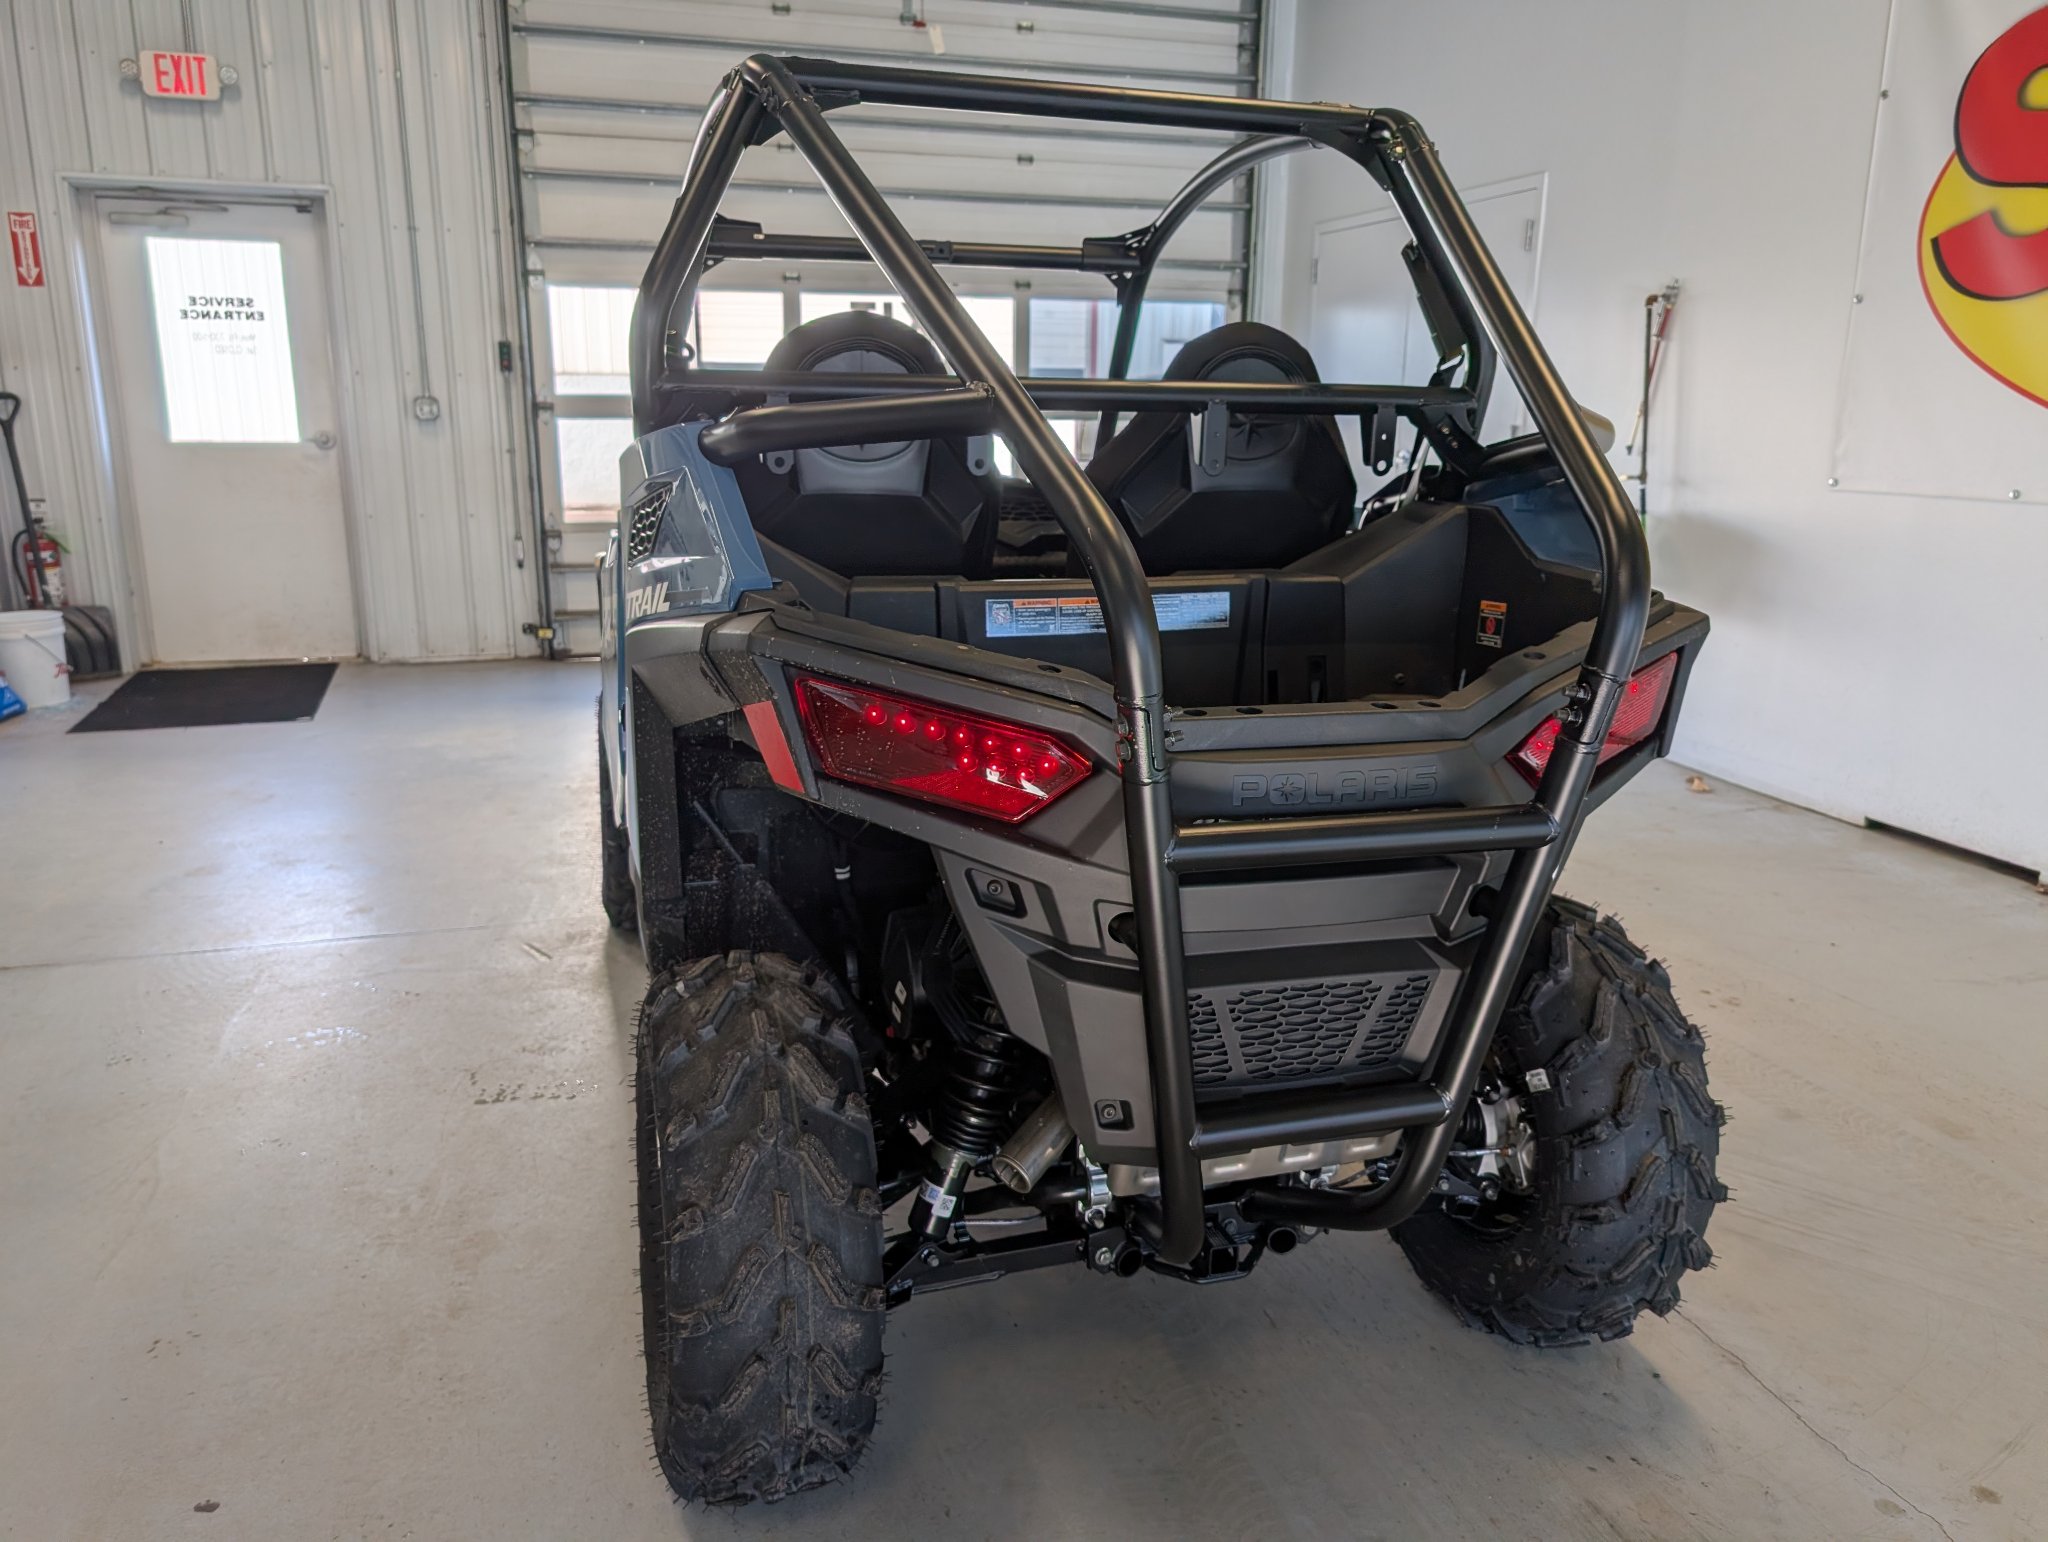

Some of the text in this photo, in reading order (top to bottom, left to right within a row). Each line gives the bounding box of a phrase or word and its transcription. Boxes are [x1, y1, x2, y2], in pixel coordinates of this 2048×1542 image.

[153, 52, 207, 96] EXIT
[13, 219, 33, 230] FIRE
[625, 581, 671, 620] TRAIL
[1232, 765, 1439, 807] POLARIS
